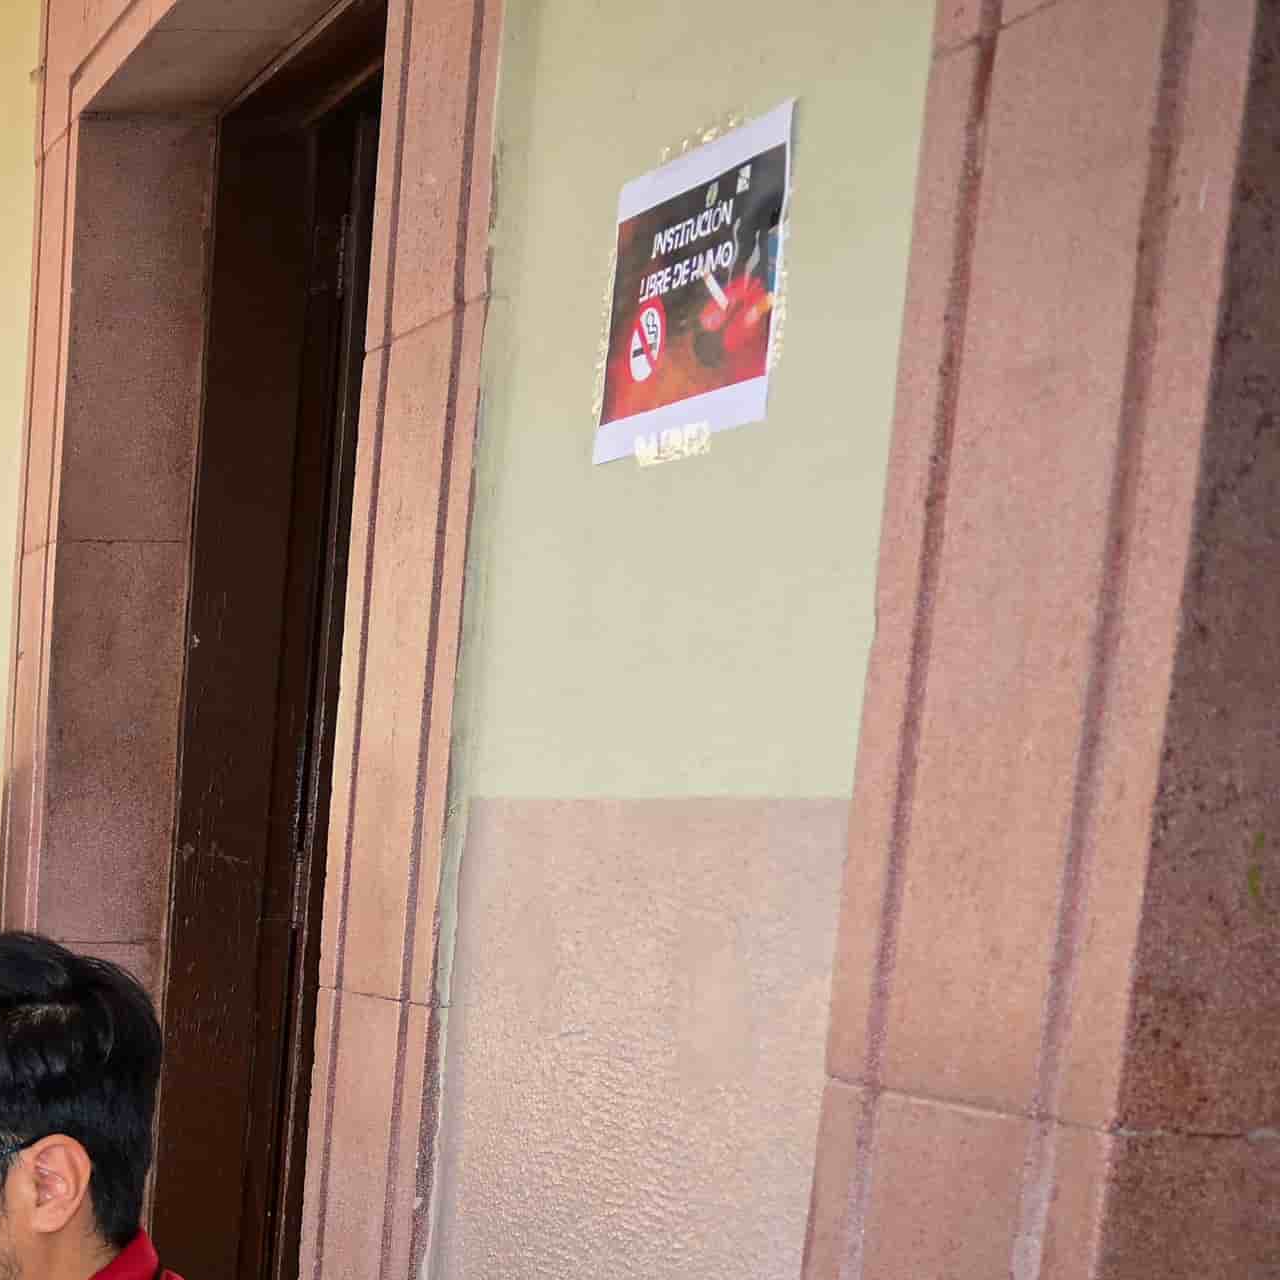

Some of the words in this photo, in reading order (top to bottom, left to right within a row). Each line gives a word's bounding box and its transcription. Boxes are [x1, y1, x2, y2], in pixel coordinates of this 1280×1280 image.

[651, 198, 734, 259] INSTITUCIÓN
[639, 267, 671, 303] LIBRE
[672, 259, 691, 289] DE
[690, 241, 733, 281] HUMO
